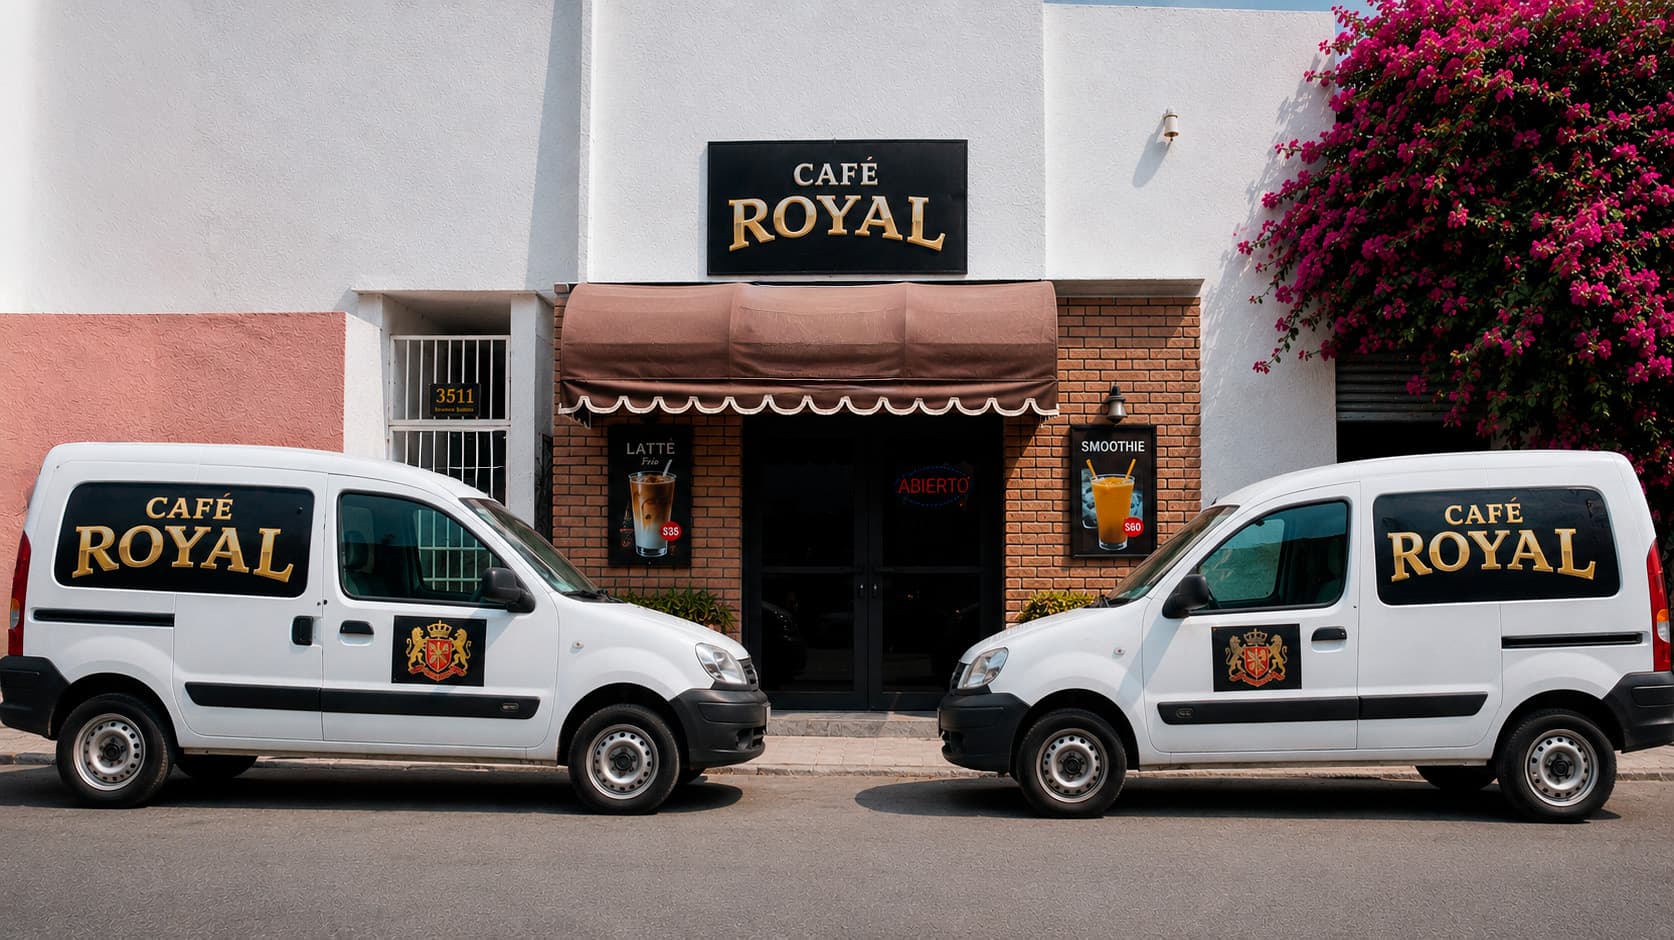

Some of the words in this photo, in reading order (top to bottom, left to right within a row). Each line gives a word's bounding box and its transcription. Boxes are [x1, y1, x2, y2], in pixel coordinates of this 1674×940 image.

[793, 156, 878, 186] CAFÉ
[728, 194, 946, 251] ROYAL
[435, 387, 475, 404] 3511
[1081, 440, 1146, 453] SMOOTHIE
[897, 477, 969, 494] ABIERTO
[146, 492, 233, 520] CAFÉ
[1444, 496, 1524, 526] CAFÉ
[72, 524, 294, 583] ROYAL
[1387, 528, 1596, 582] ROYAL
